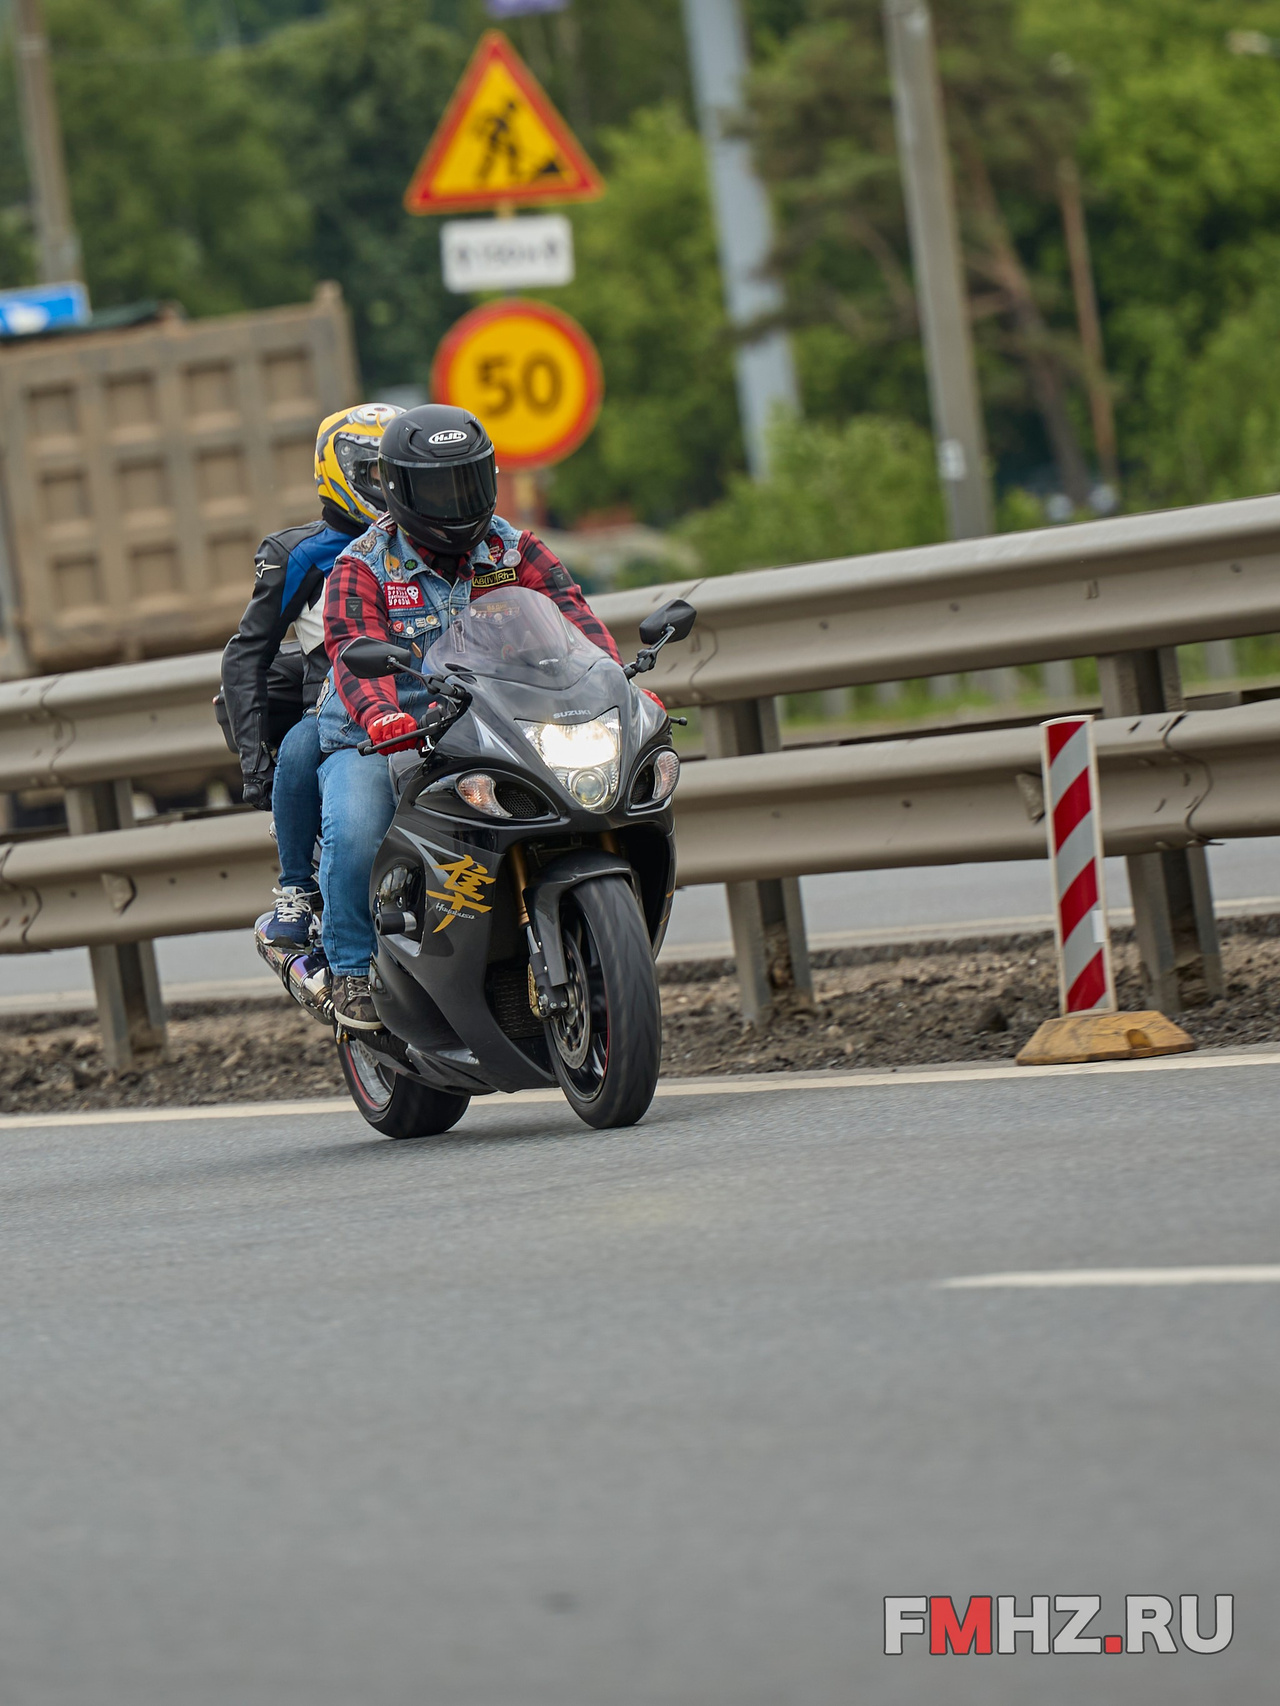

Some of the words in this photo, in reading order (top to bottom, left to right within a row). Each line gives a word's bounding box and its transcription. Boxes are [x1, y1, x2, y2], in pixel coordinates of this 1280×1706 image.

[476, 351, 562, 418] 50
[432, 432, 463, 442] HJC
[553, 709, 591, 719] SUZUKI
